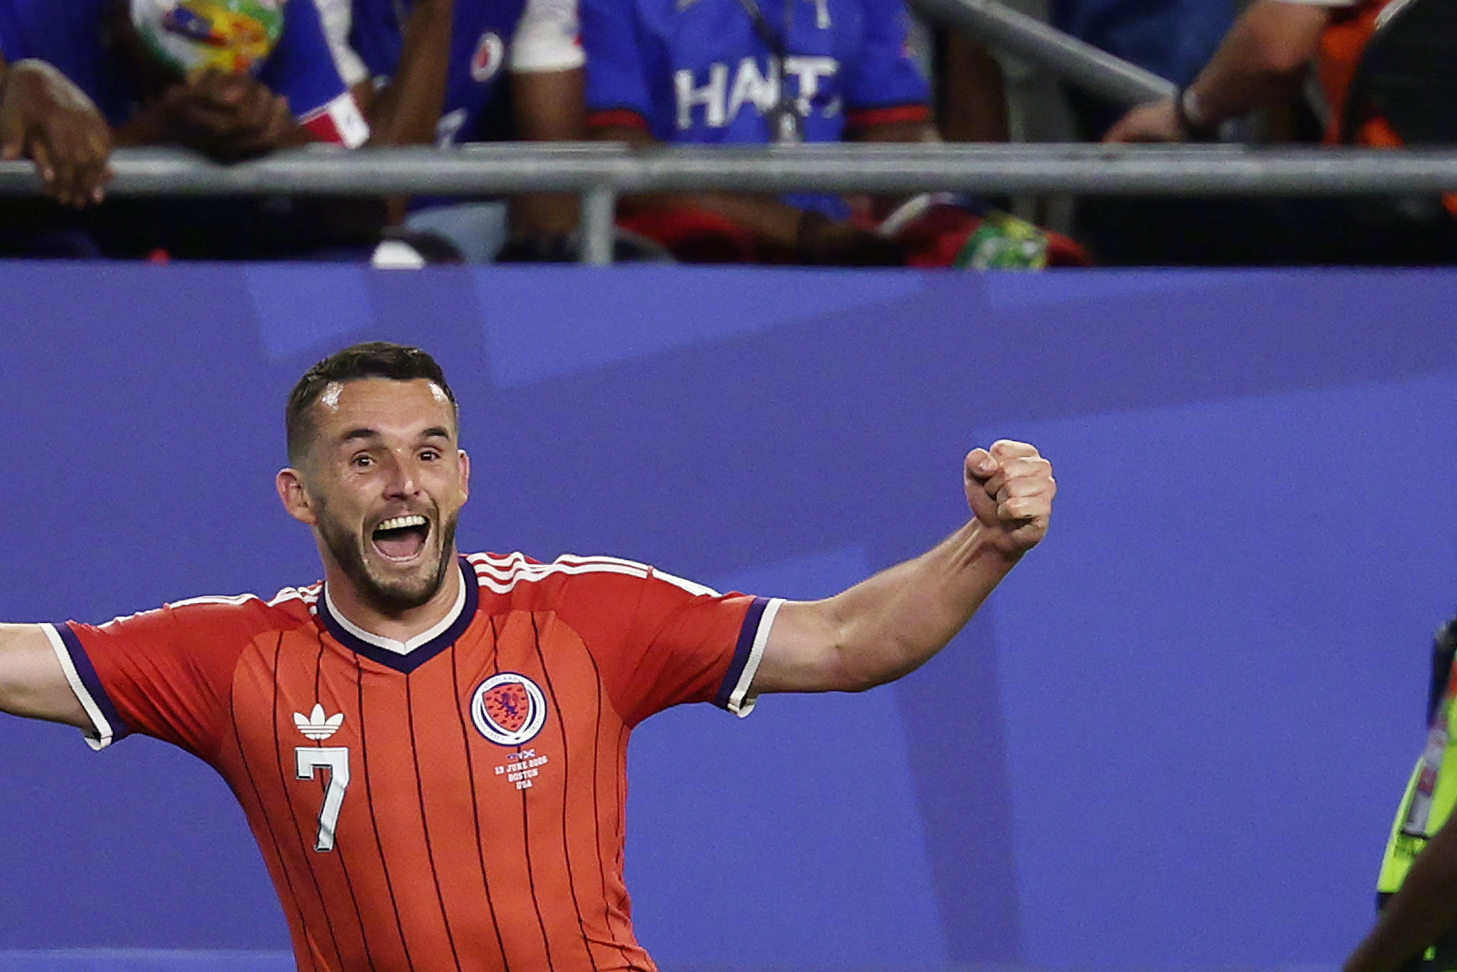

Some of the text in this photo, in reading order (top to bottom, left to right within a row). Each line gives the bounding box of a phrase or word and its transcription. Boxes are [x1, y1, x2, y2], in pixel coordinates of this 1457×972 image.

[506, 760, 528, 773] JUNE
[507, 768, 539, 782] BOSTON
[516, 779, 533, 790] USA
[294, 746, 350, 852] 7
